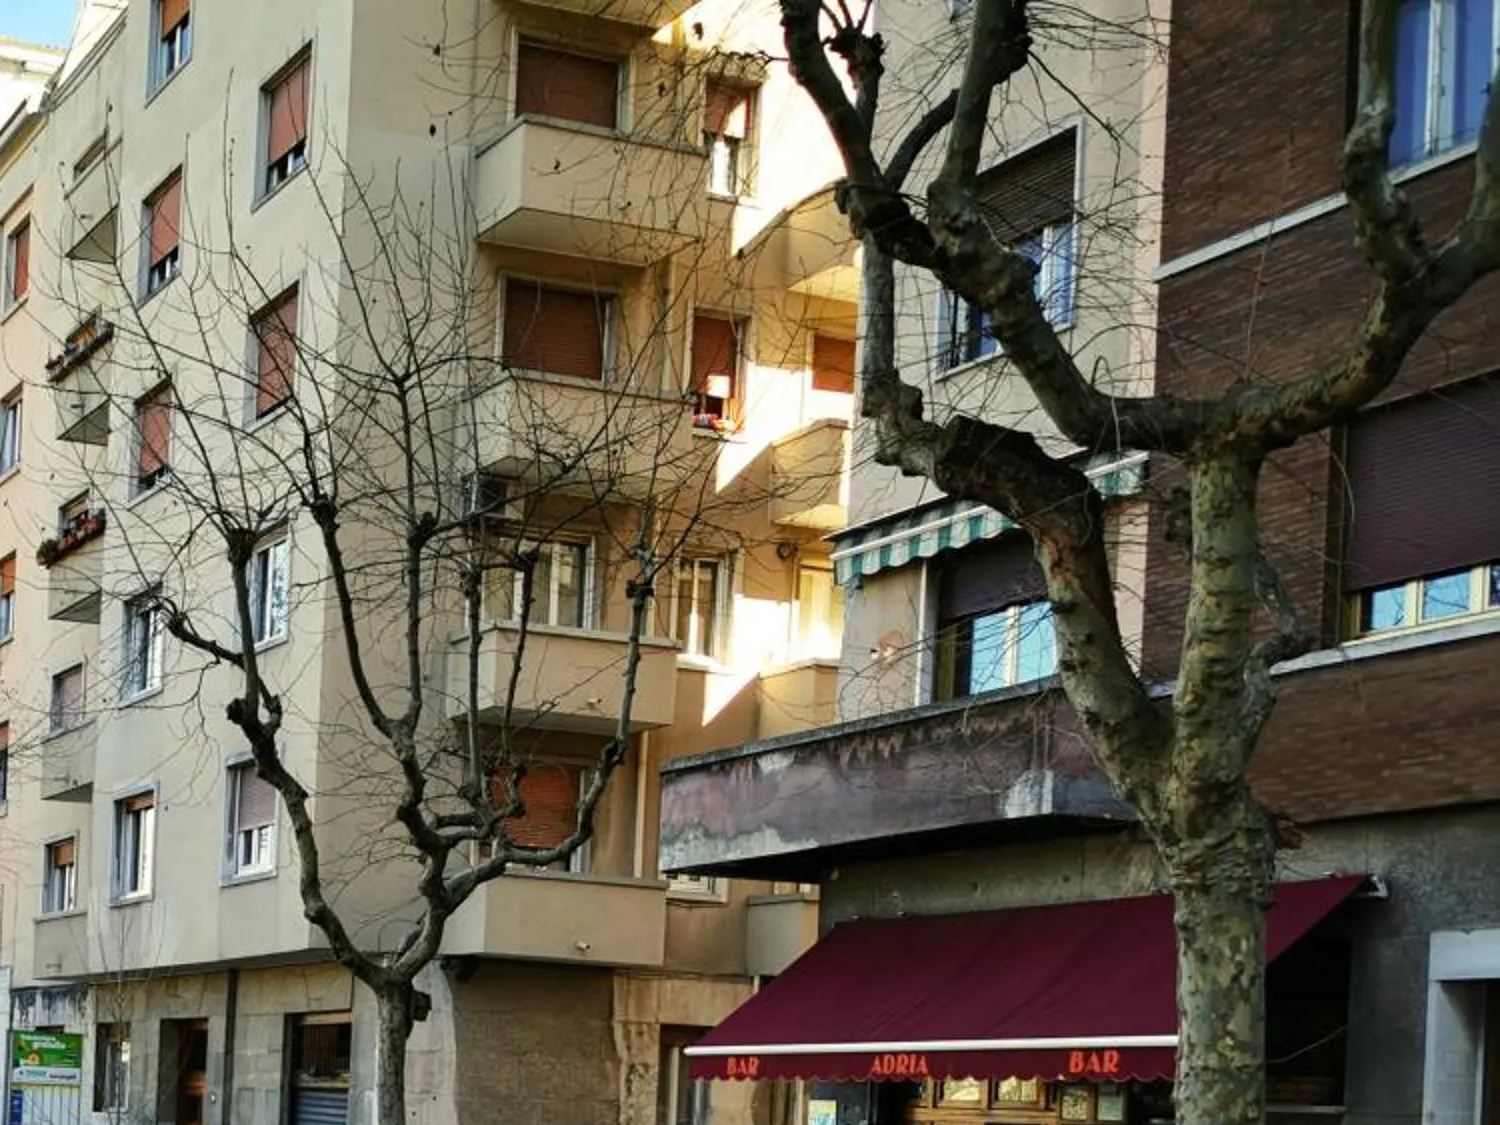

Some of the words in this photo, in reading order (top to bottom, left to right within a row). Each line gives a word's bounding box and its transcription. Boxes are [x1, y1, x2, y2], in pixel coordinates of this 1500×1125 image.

[726, 1056, 759, 1076] BAR
[871, 1053, 929, 1075] ADRIA
[1068, 1048, 1119, 1074] BAR
